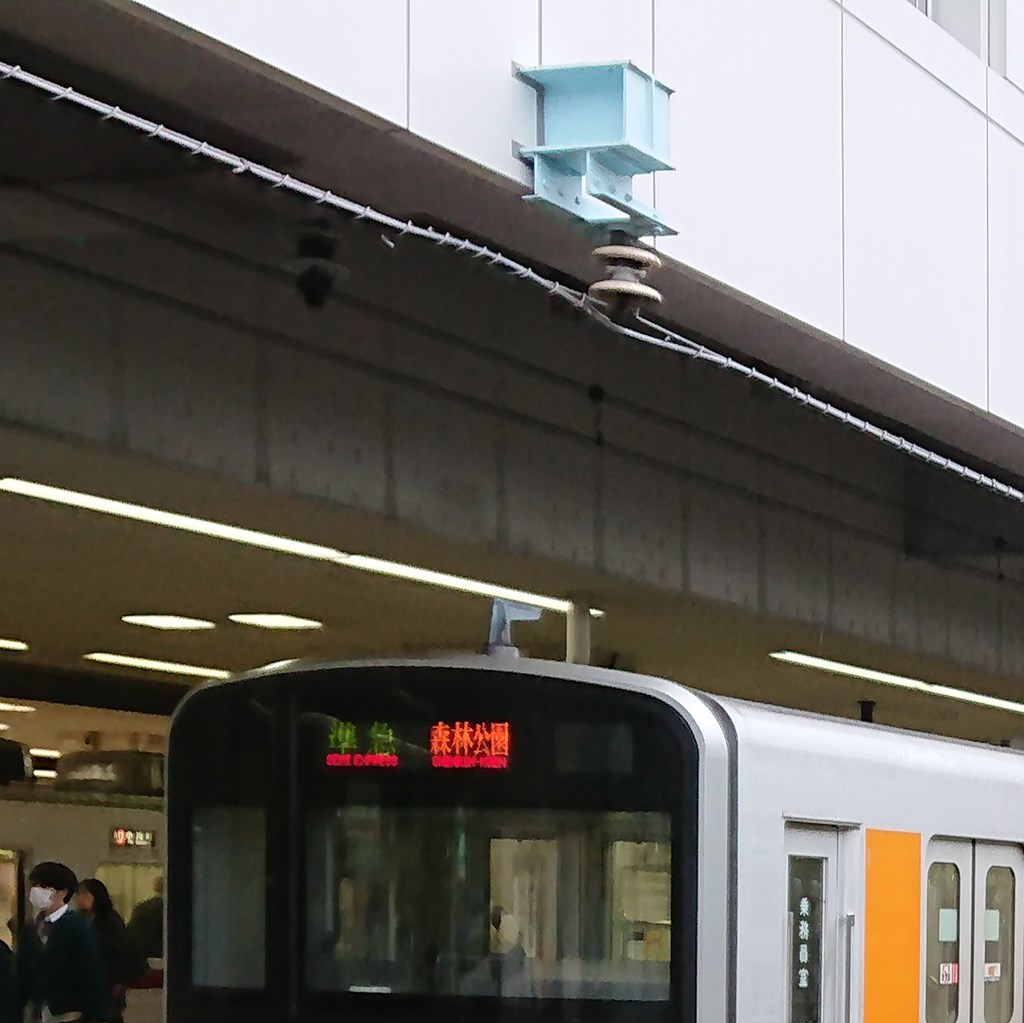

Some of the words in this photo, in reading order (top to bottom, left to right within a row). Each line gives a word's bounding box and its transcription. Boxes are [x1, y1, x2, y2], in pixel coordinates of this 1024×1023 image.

[430, 721, 509, 756] 森林公園
[798, 896, 810, 988] 乗務員室
